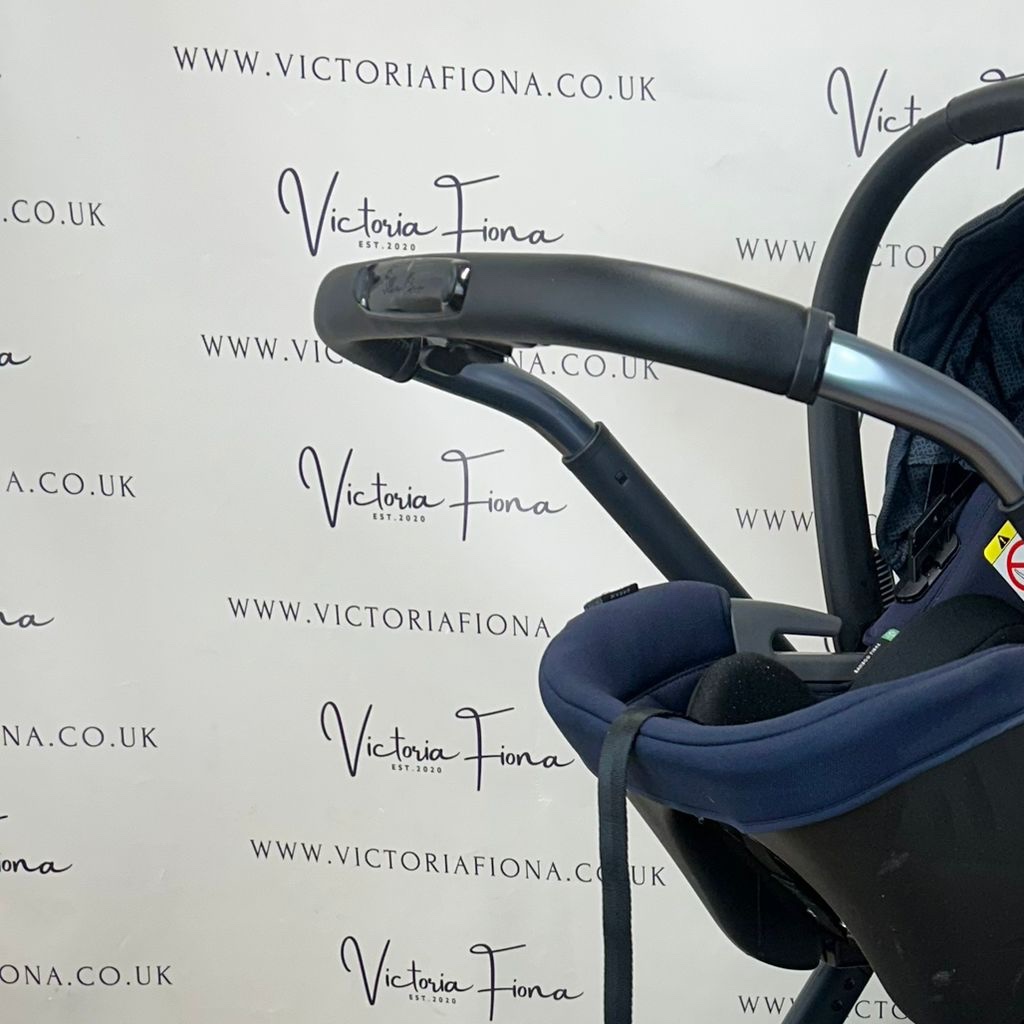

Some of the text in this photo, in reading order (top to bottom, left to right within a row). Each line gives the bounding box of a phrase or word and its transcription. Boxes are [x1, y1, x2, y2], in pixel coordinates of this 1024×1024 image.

[173, 45, 657, 102] WWW.VICTORIAFIONA.CO.UK
[277, 167, 565, 258] Victoria Fiona
[358, 240, 416, 252] EST.2020
[298, 445, 570, 542] Victoria Fiona
[372, 512, 426, 523] EST.2020
[320, 700, 577, 792] Victoria Fiona
[391, 763, 442, 774] EST.2020
[247, 836, 669, 889] WWW.VICTORIAFIONA.C.UK
[340, 935, 585, 1022] Victoria Fiona
[408, 993, 457, 1005] EST.2020
